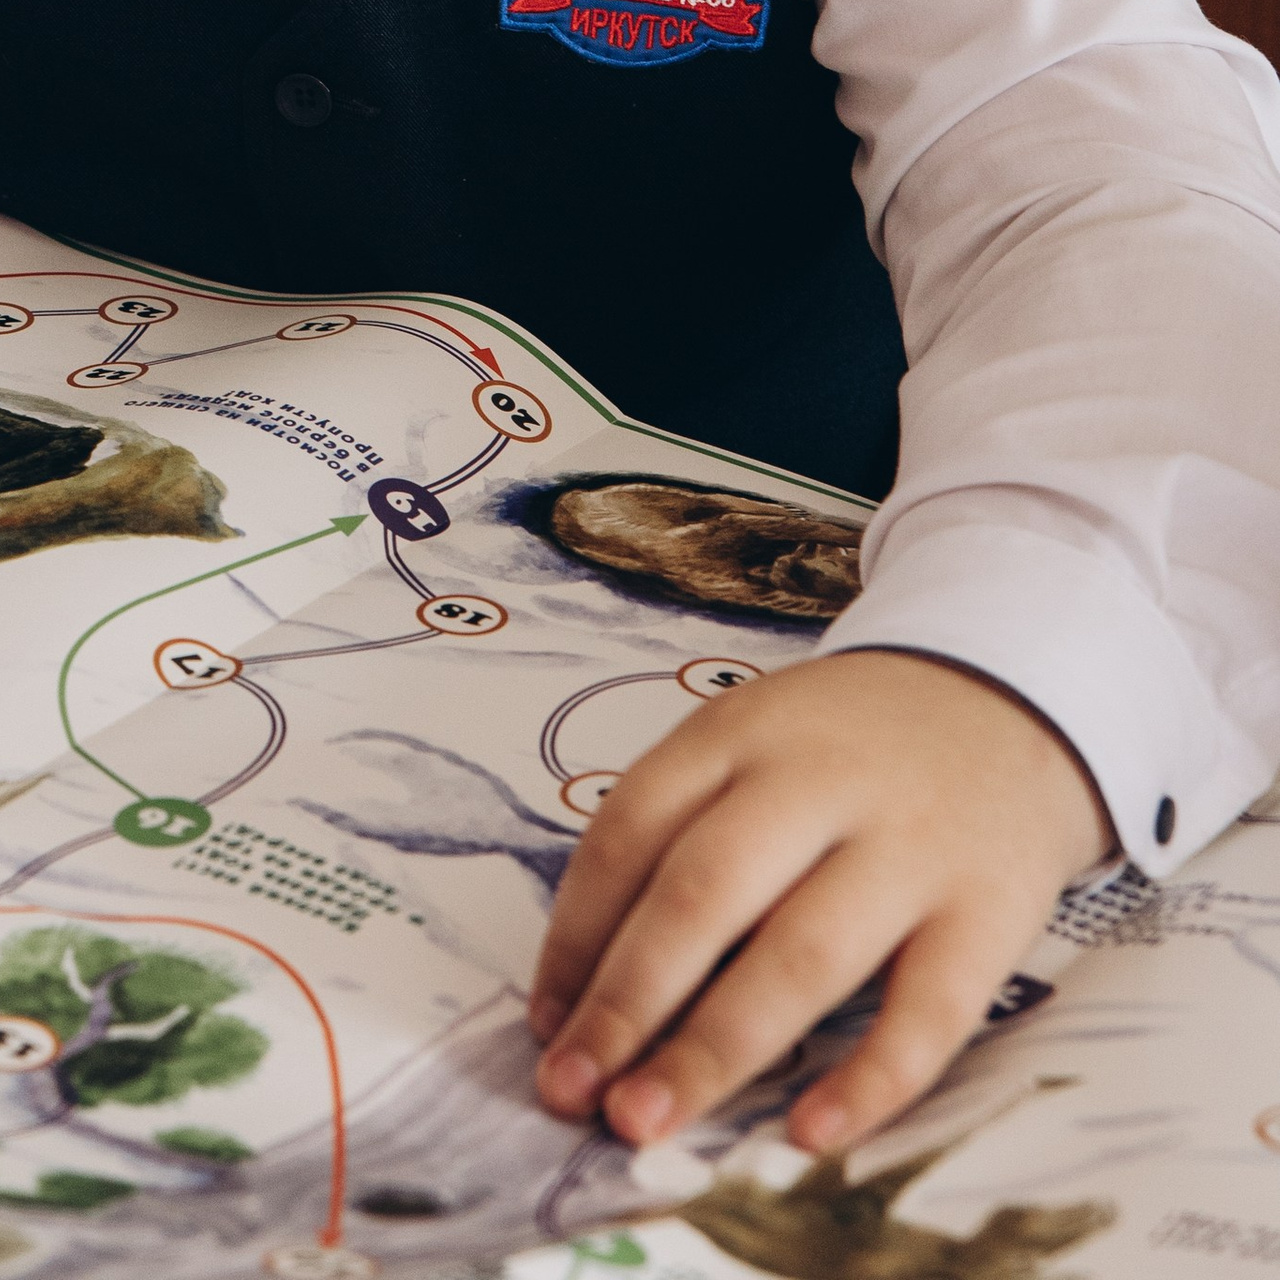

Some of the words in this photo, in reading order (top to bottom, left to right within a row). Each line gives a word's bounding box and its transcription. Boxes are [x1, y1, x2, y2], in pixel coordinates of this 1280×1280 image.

[570, 7, 698, 51] ИРКУТСК
[117, 301, 166, 319] 23
[293, 321, 341, 333] 21
[85, 368, 134, 381] 22
[124, 399, 210, 414] спящего
[222, 390, 276, 406] ход!
[214, 408, 241, 421] на
[490, 392, 540, 432] 20
[259, 410, 350, 460] берлоге
[279, 403, 384, 466] Пропусти
[246, 418, 356, 483] Посмотри
[355, 462, 370, 474] в
[385, 490, 438, 532] 19
[433, 603, 492, 628] 18
[170, 653, 227, 679] 17
[137, 806, 198, 838] 16
